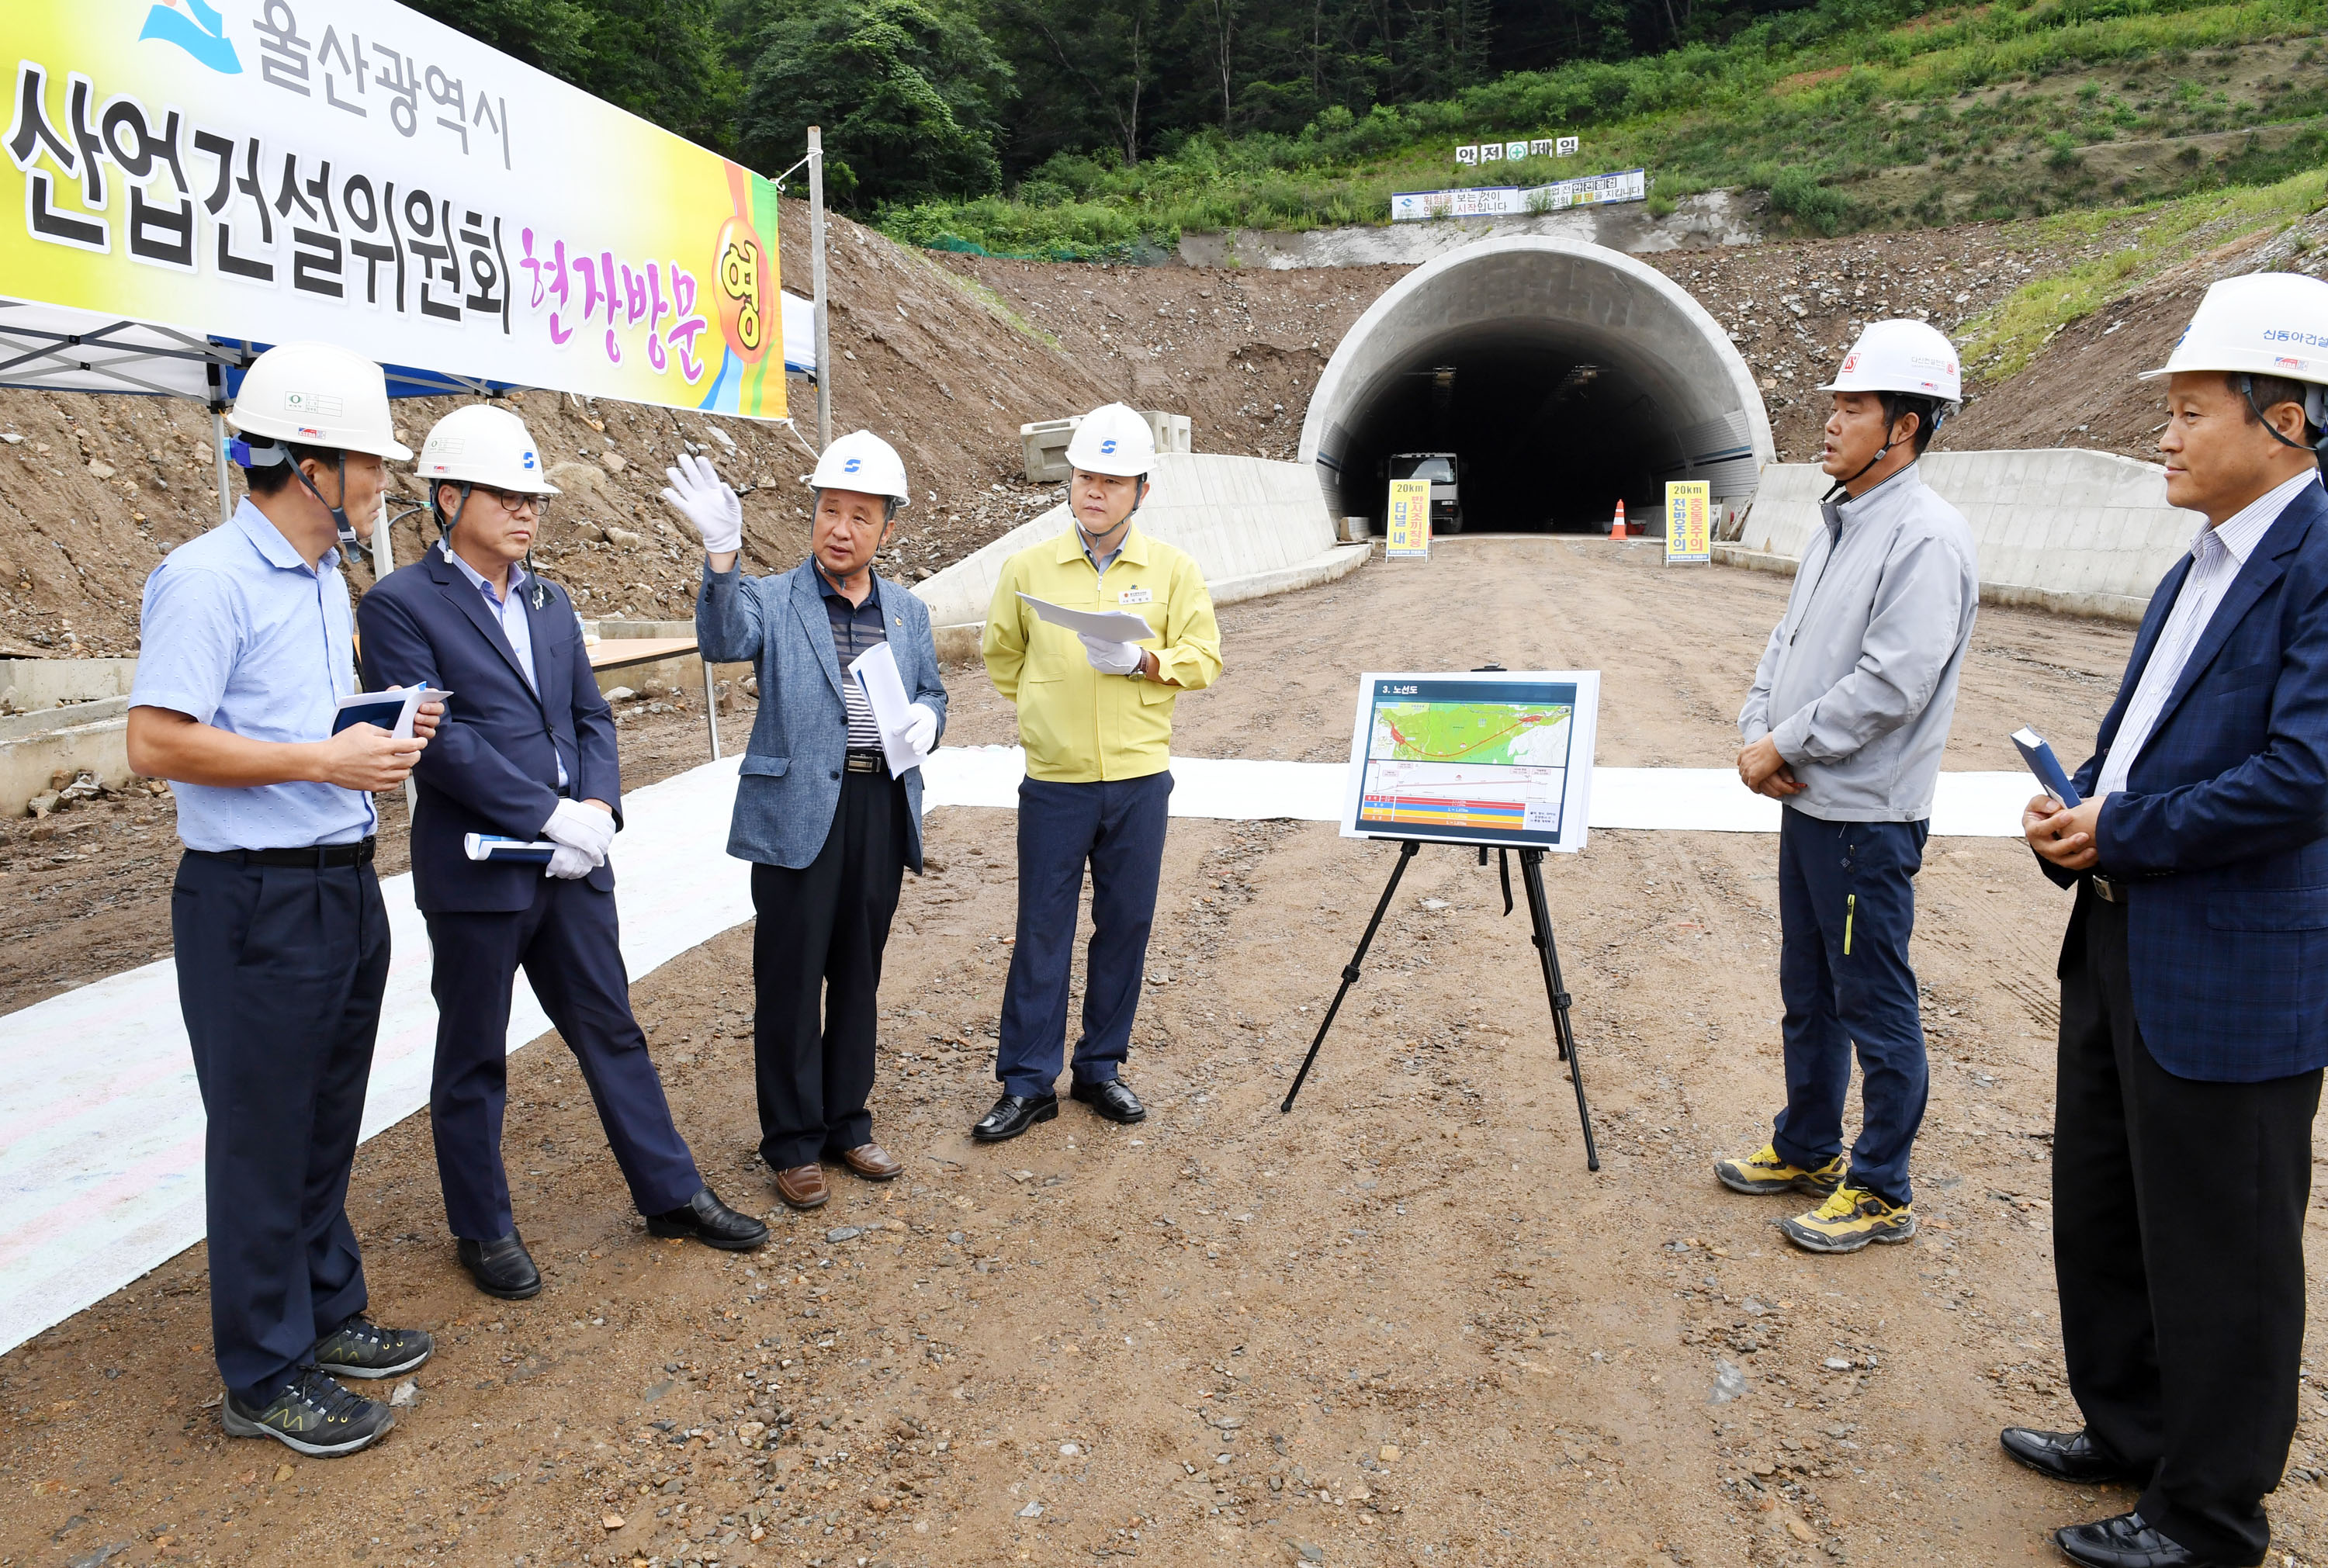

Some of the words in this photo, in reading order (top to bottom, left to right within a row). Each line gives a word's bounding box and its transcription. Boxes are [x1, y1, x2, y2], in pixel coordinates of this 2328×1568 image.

[253, 0, 511, 171] 울산광역시
[1459, 146, 1499, 164] 안전
[1573, 178, 1616, 193] 안전점검
[1606, 186, 1640, 198] 지킵니다
[1423, 194, 1453, 205] 위험을
[1457, 192, 1476, 202] 보는
[1481, 191, 1500, 202] 것이
[1457, 202, 1506, 213] 시작입니다
[9, 69, 512, 335] 산업건설위원회
[519, 227, 706, 381] 현장방문
[720, 240, 761, 351] 영
[1397, 483, 1423, 493] 20km
[1674, 485, 1702, 494] 20km
[1394, 501, 1407, 528] 터널
[1672, 498, 1686, 552] 전방주의
[1690, 497, 1703, 552] 충돌주의
[1393, 531, 1406, 544] 내
[1382, 685, 1391, 694] 3.
[1392, 685, 1419, 695] 노선도
